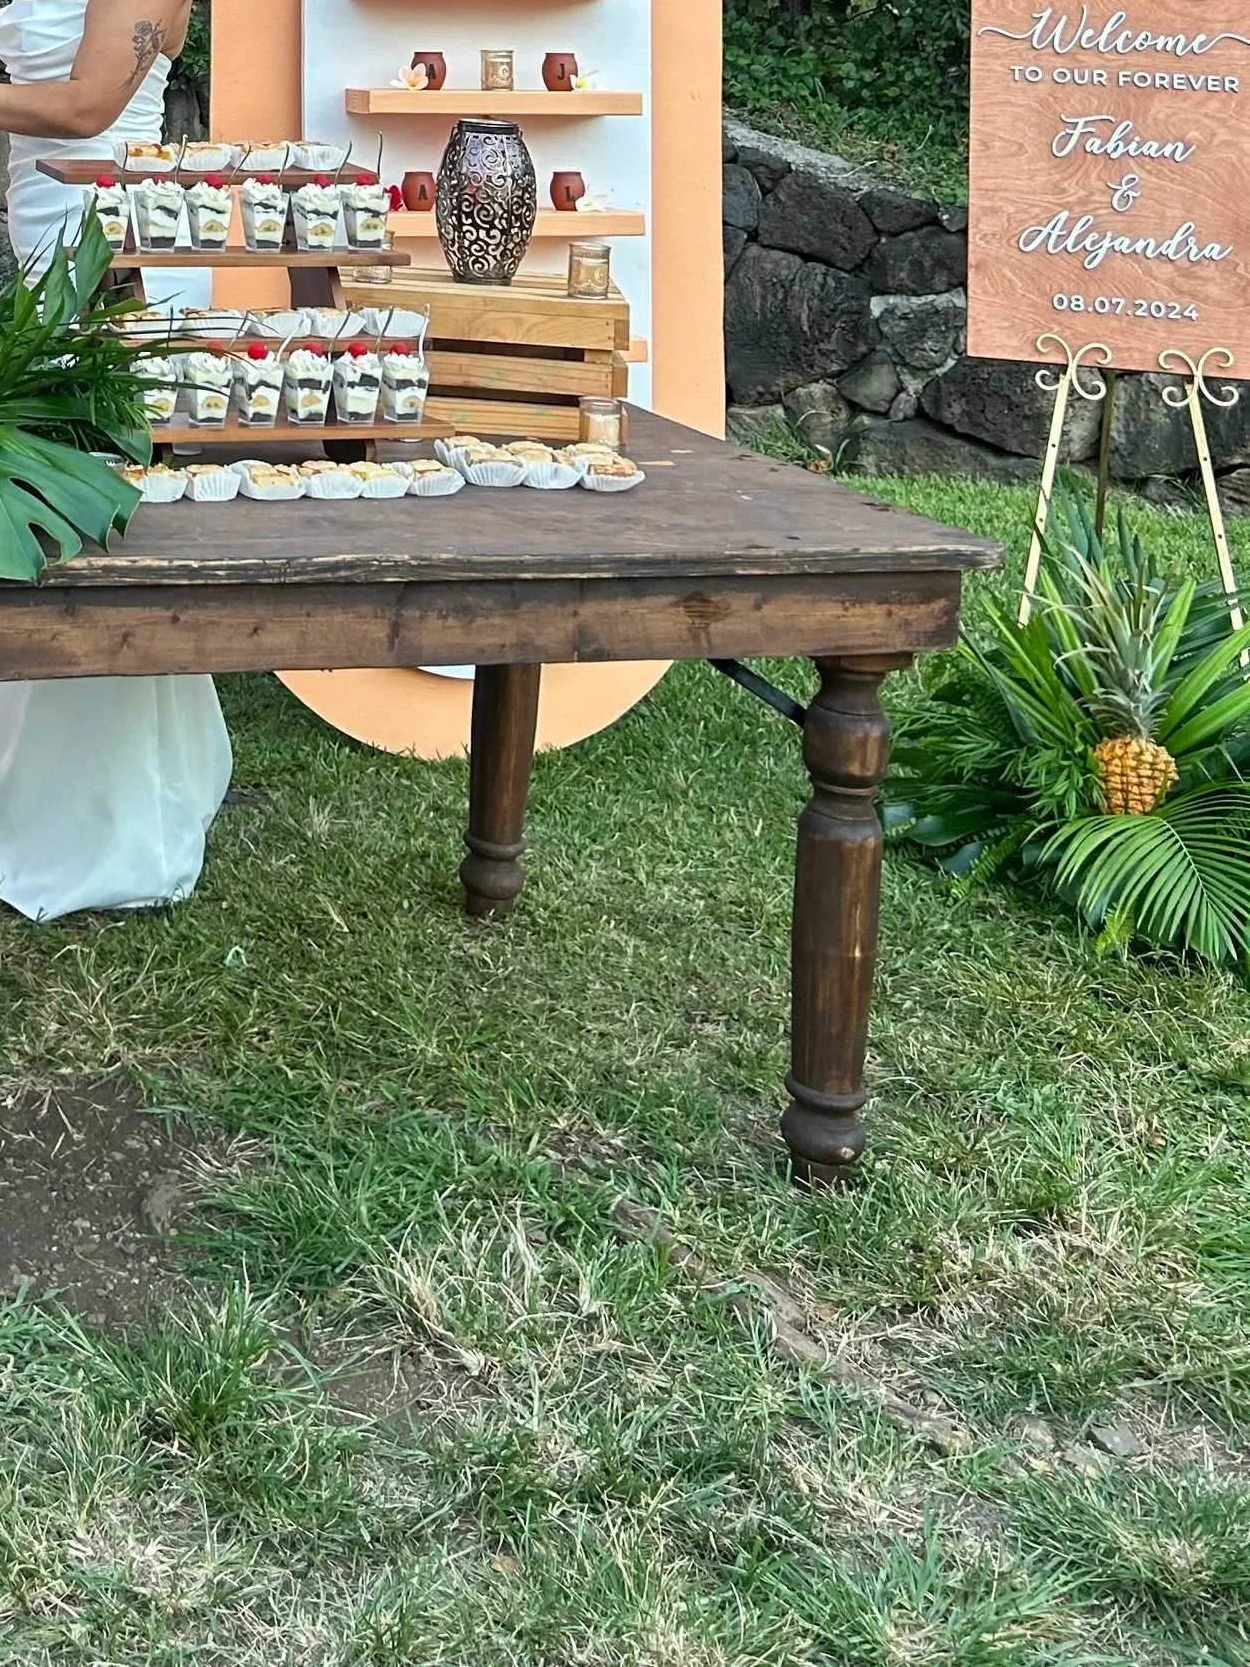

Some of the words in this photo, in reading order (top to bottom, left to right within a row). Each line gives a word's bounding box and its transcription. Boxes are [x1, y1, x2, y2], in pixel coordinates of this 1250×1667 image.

[978, 5, 1250, 57] Welcome
[557, 63, 565, 80] J
[1009, 65, 1043, 82] TO
[1052, 67, 1107, 86] OUR
[1118, 71, 1240, 93] FOREVER
[1051, 114, 1196, 162] Fabian
[419, 184, 428, 200] A
[565, 186, 575, 202] L
[1107, 173, 1141, 212] &
[1018, 210, 1234, 270] Alejandra
[1052, 293, 1199, 321] 08.07.2024
